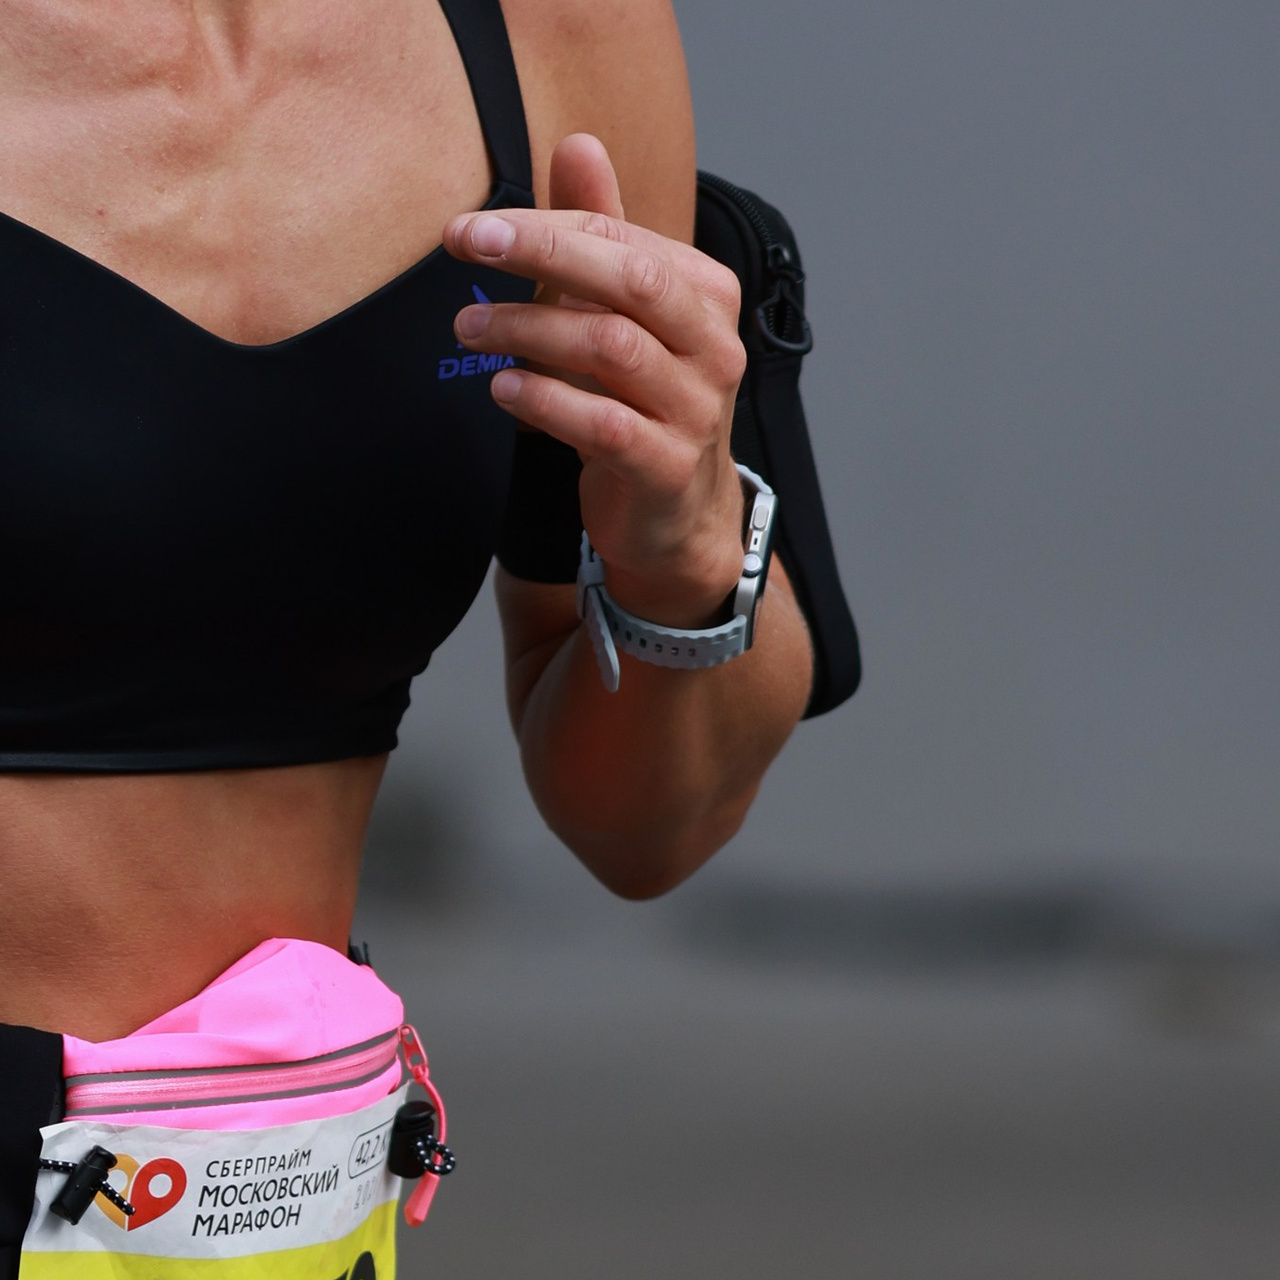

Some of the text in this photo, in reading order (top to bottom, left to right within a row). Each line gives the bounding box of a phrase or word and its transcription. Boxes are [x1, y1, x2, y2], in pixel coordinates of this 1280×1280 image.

[206, 1149, 312, 1178] СБЕРПРАЙМ
[198, 1164, 340, 1208] МОСКОВСКИЙ
[192, 1204, 302, 1237] МАРАФОН
